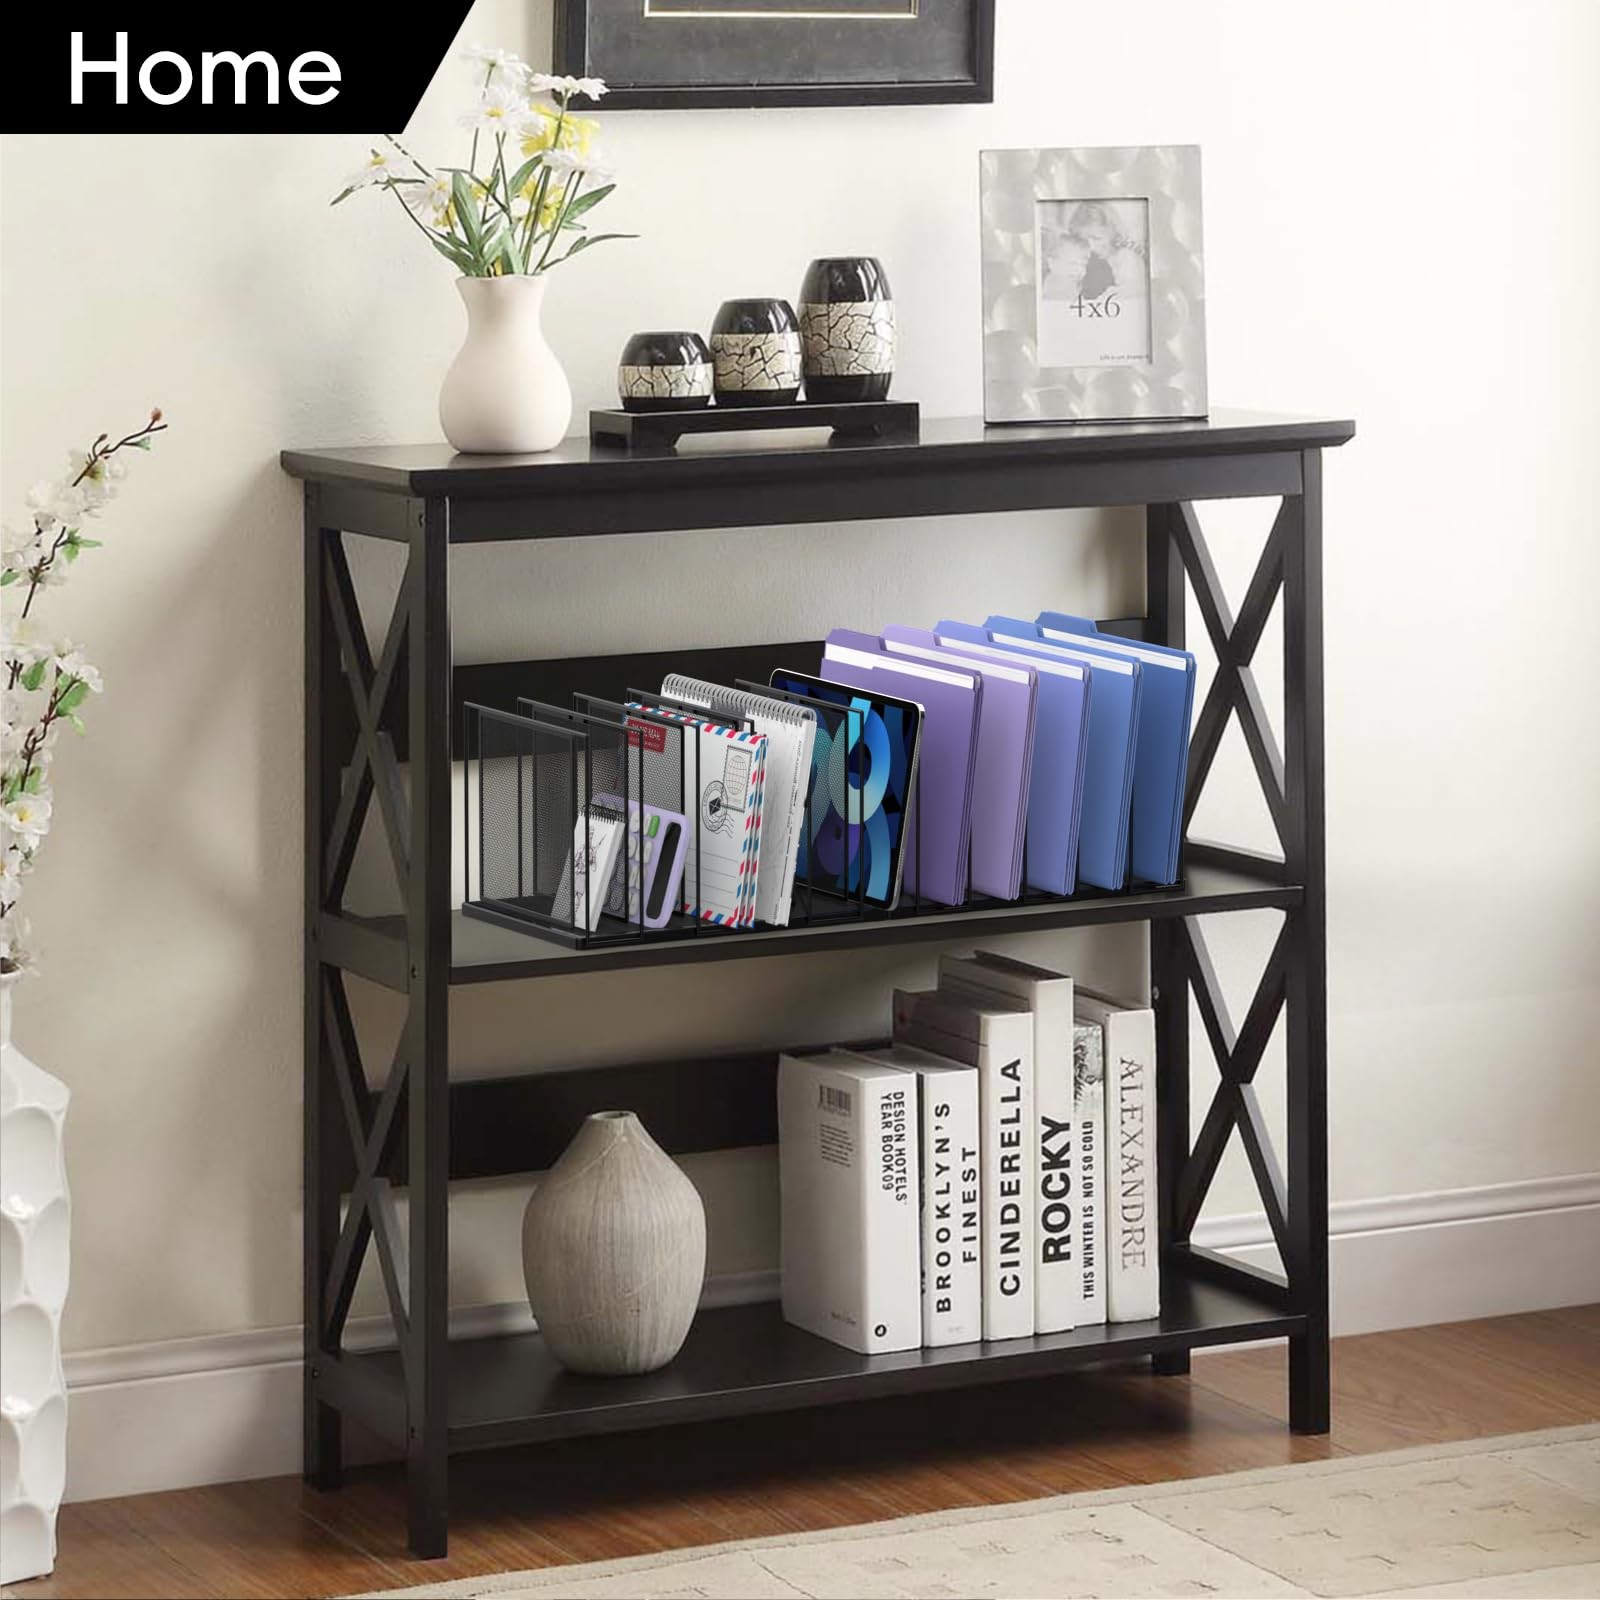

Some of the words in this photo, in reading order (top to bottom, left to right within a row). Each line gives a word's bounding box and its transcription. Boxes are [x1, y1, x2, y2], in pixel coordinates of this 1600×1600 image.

[1069, 292, 1121, 318] 4x6
[880, 1092, 893, 1130] YEAR
[893, 1091, 906, 1142] DESIGN
[1082, 1121, 1094, 1151] COLD
[894, 1148, 908, 1202] HOTELS
[1000, 1058, 1021, 1296] CINDERELLA
[1082, 1154, 1094, 1171] SO
[1120, 1056, 1146, 1271] ALEXANDRE
[935, 1102, 951, 1314] BROOKLYN'S
[962, 1147, 977, 1264] FINEST
[1041, 1116, 1071, 1264] ROCKY
[1082, 1175, 1094, 1198] NOT
[1083, 1205, 1094, 1217] IS
[1083, 1221, 1095, 1265] WINTER
[1083, 1266, 1095, 1300] THIS
